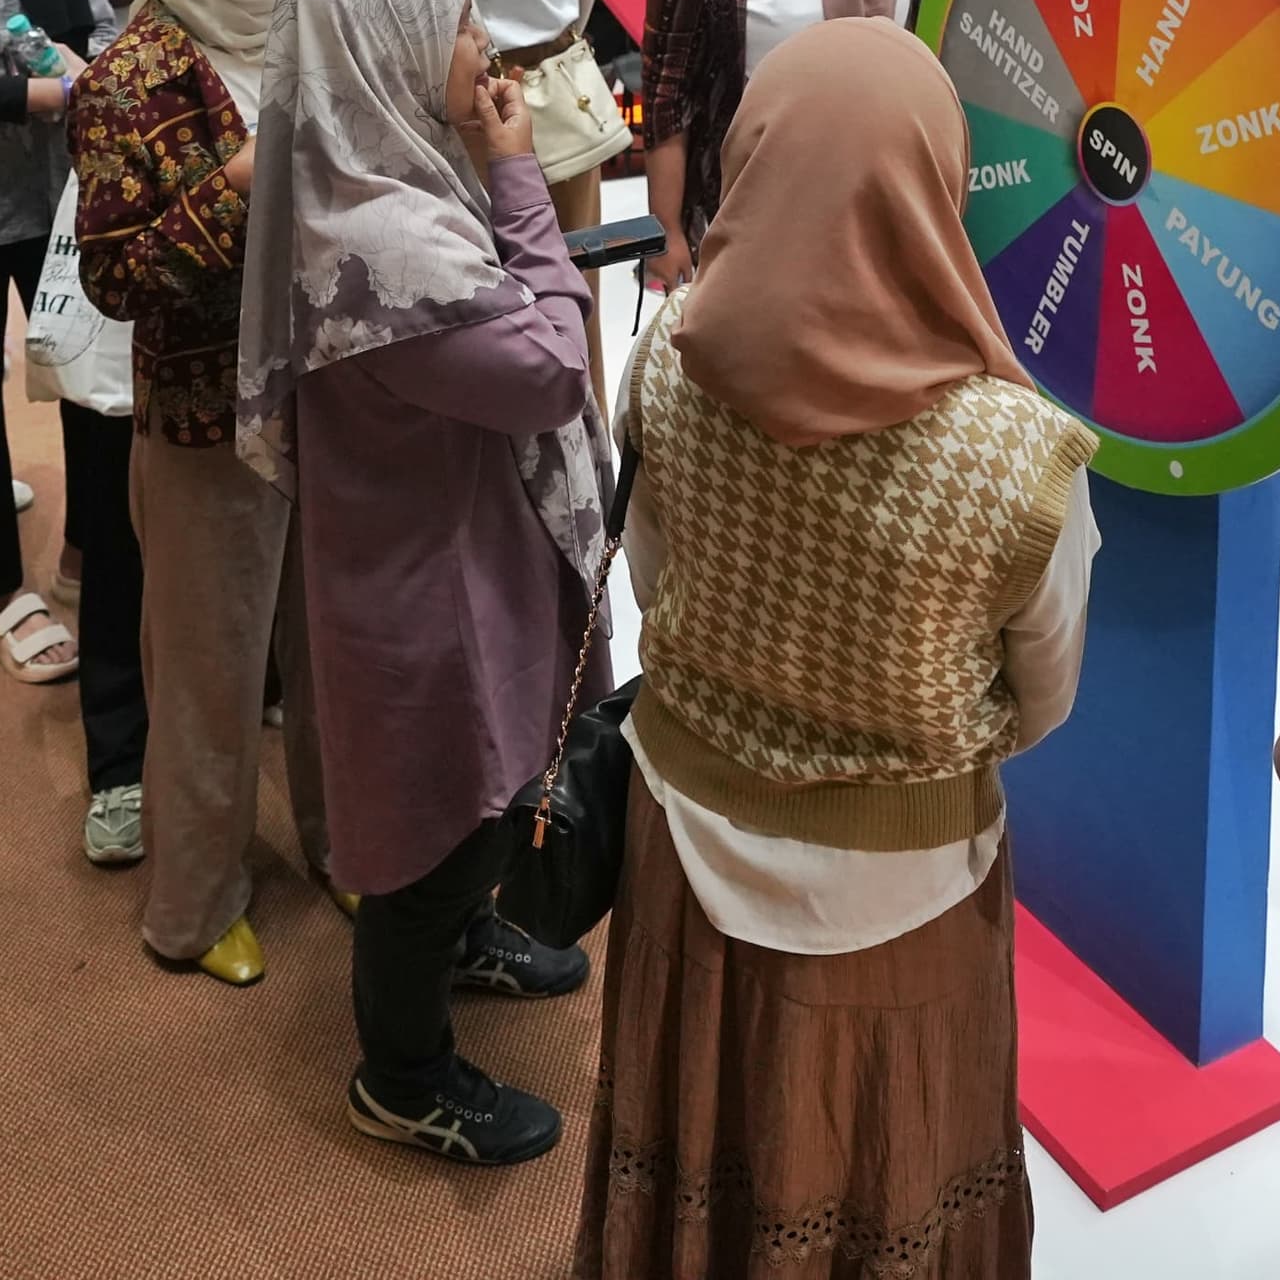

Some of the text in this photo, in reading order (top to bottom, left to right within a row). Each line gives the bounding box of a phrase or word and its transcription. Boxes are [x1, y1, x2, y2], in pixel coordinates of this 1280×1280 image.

[959, 12, 1061, 123] SANITIZER
[987, 9, 1045, 75] HAND
[968, 158, 1031, 192] ZONK
[1088, 129, 1138, 185] SPIN
[1023, 220, 1091, 355] TUMBLER
[1121, 262, 1157, 375] ZONK
